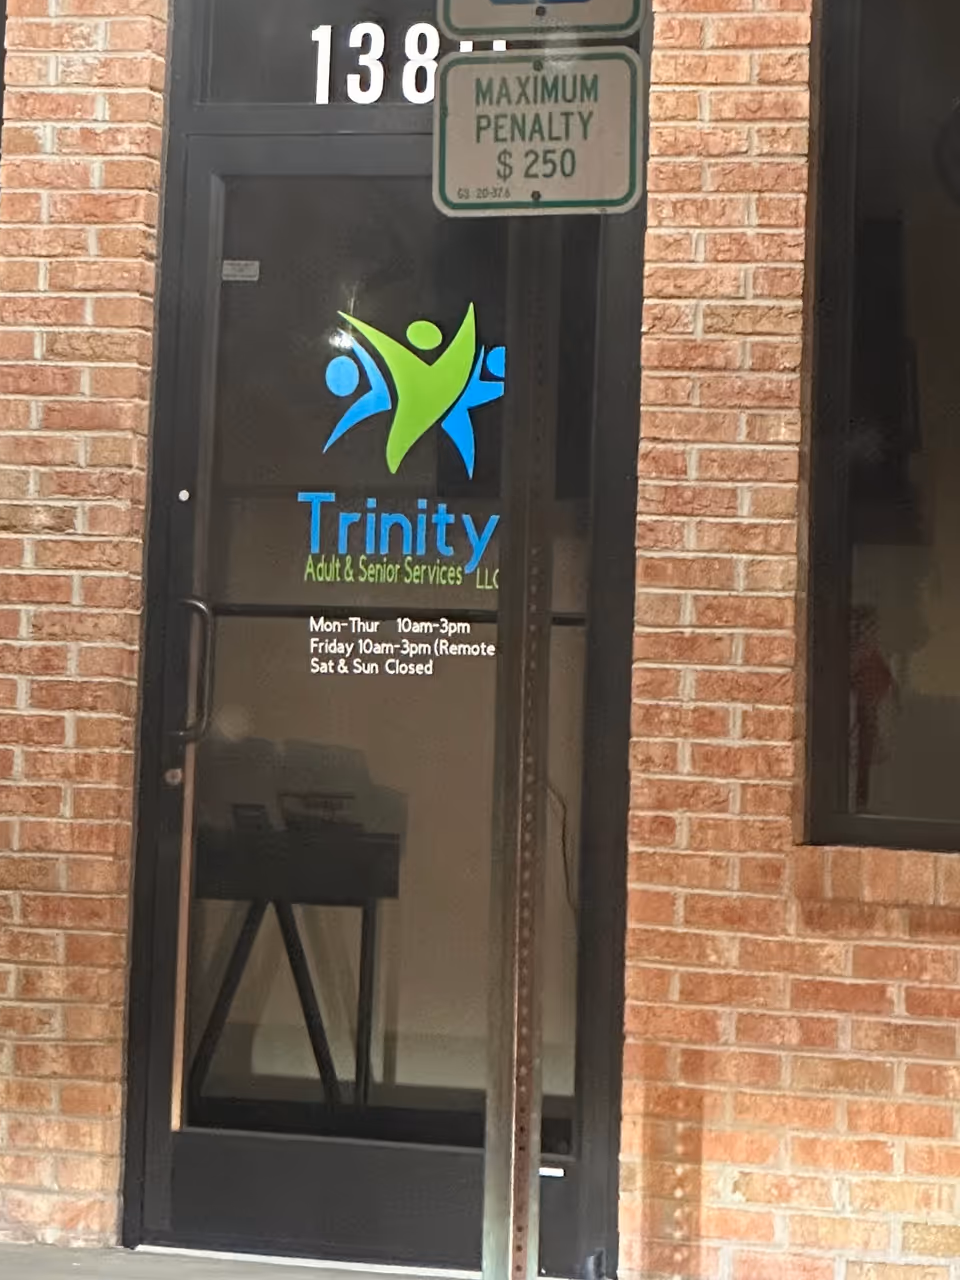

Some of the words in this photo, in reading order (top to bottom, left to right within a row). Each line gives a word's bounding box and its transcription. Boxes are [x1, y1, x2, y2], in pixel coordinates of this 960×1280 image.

[311, 22, 506, 105] 138
[474, 73, 599, 107] MAXIMUM
[475, 111, 594, 144] PENALTY
[496, 148, 513, 182] $
[523, 147, 577, 179] 250
[297, 491, 501, 575] Trinity
[304, 555, 341, 582] Adult
[344, 556, 354, 581] &
[358, 555, 400, 583] Senior
[403, 556, 463, 585] Services
[309, 616, 380, 634] Mon-Thur
[396, 618, 471, 637] 10am-3pm
[310, 638, 354, 658] Friday
[357, 639, 431, 657] 10am-3pm
[310, 659, 334, 674] Sat
[337, 659, 348, 673] &
[352, 659, 379, 675] Sun
[385, 658, 434, 675] Closed
